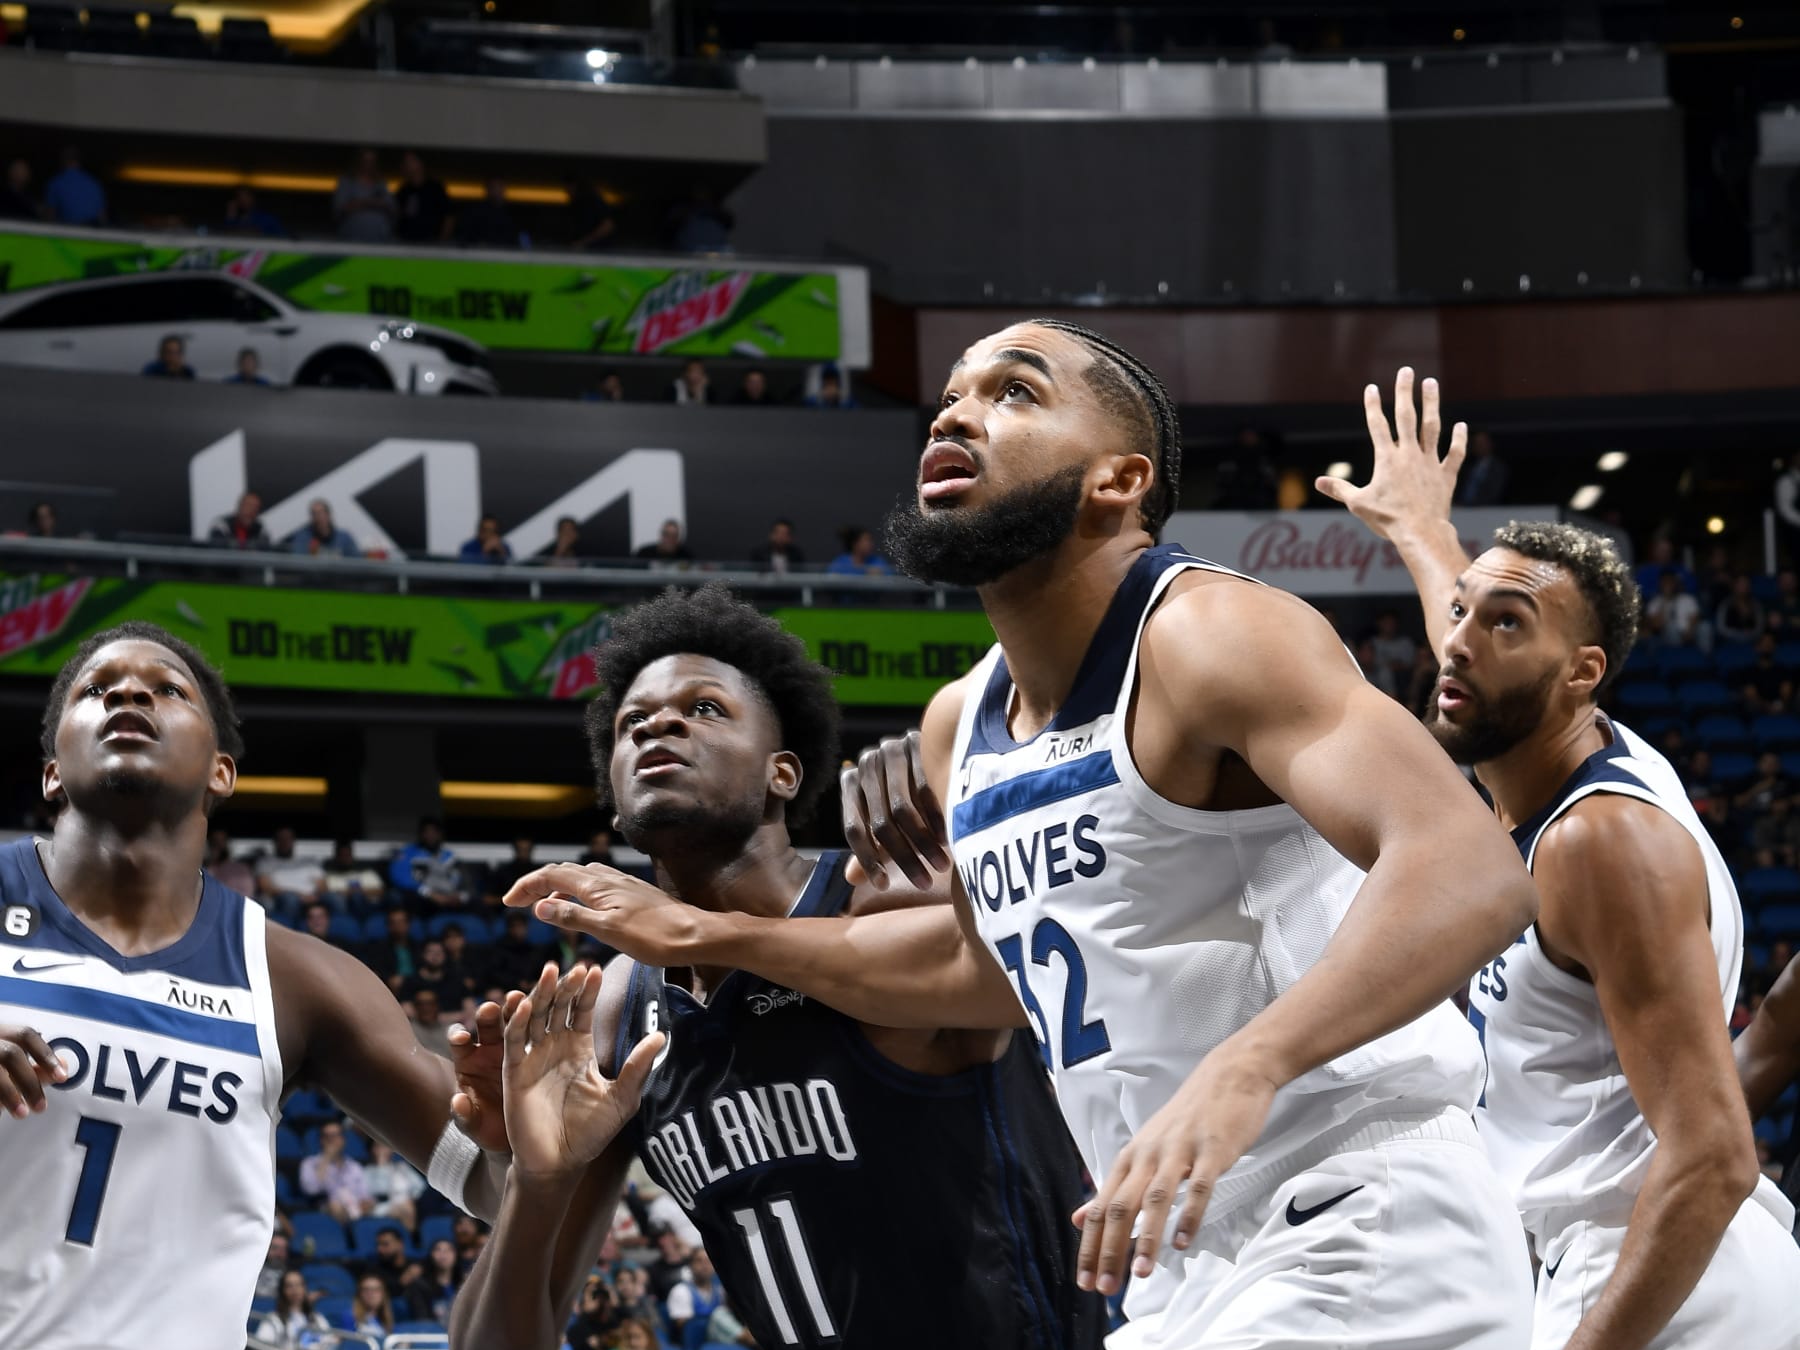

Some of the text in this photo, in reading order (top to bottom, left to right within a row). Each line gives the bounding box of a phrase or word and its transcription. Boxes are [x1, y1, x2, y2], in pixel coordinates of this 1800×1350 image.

[369, 285, 412, 316] DO
[458, 289, 531, 322] DEW
[189, 428, 688, 563] KIA
[229, 620, 415, 665] DO THE DEW
[821, 642, 869, 677] DO
[872, 651, 919, 679] THE
[959, 813, 1107, 919] WOLVES
[4, 906, 31, 937] 6
[995, 917, 1112, 1075] 32
[47, 1036, 244, 1126] OLVES
[64, 1115, 123, 1248] 1
[647, 1079, 858, 1211] ORLANDO
[733, 1199, 836, 1345] 11
